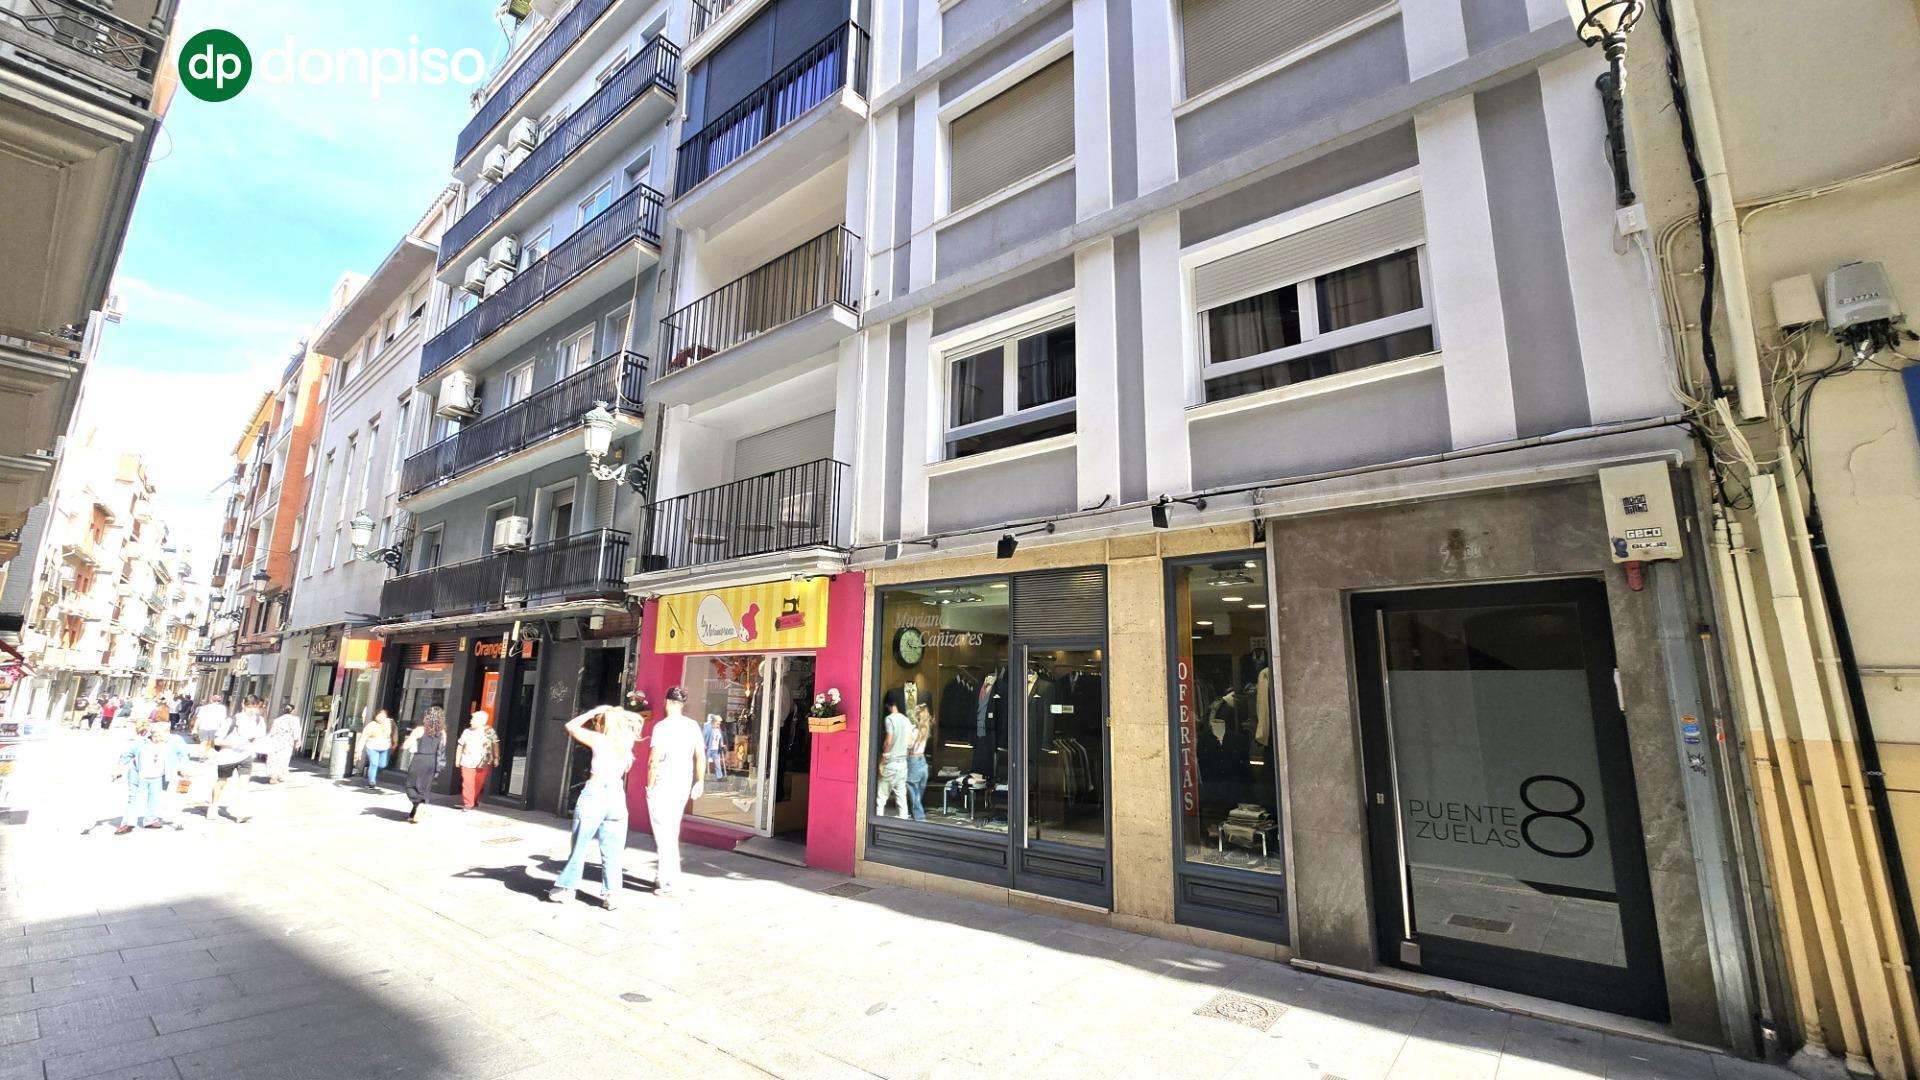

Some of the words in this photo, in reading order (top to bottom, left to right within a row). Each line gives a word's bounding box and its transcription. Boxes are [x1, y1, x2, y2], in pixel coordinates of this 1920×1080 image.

[1178, 662, 1194, 811] OFERTAS
[1408, 799, 1518, 827] PUENTE
[1519, 775, 1595, 859] 8
[1415, 820, 1520, 849] ZUELAS
